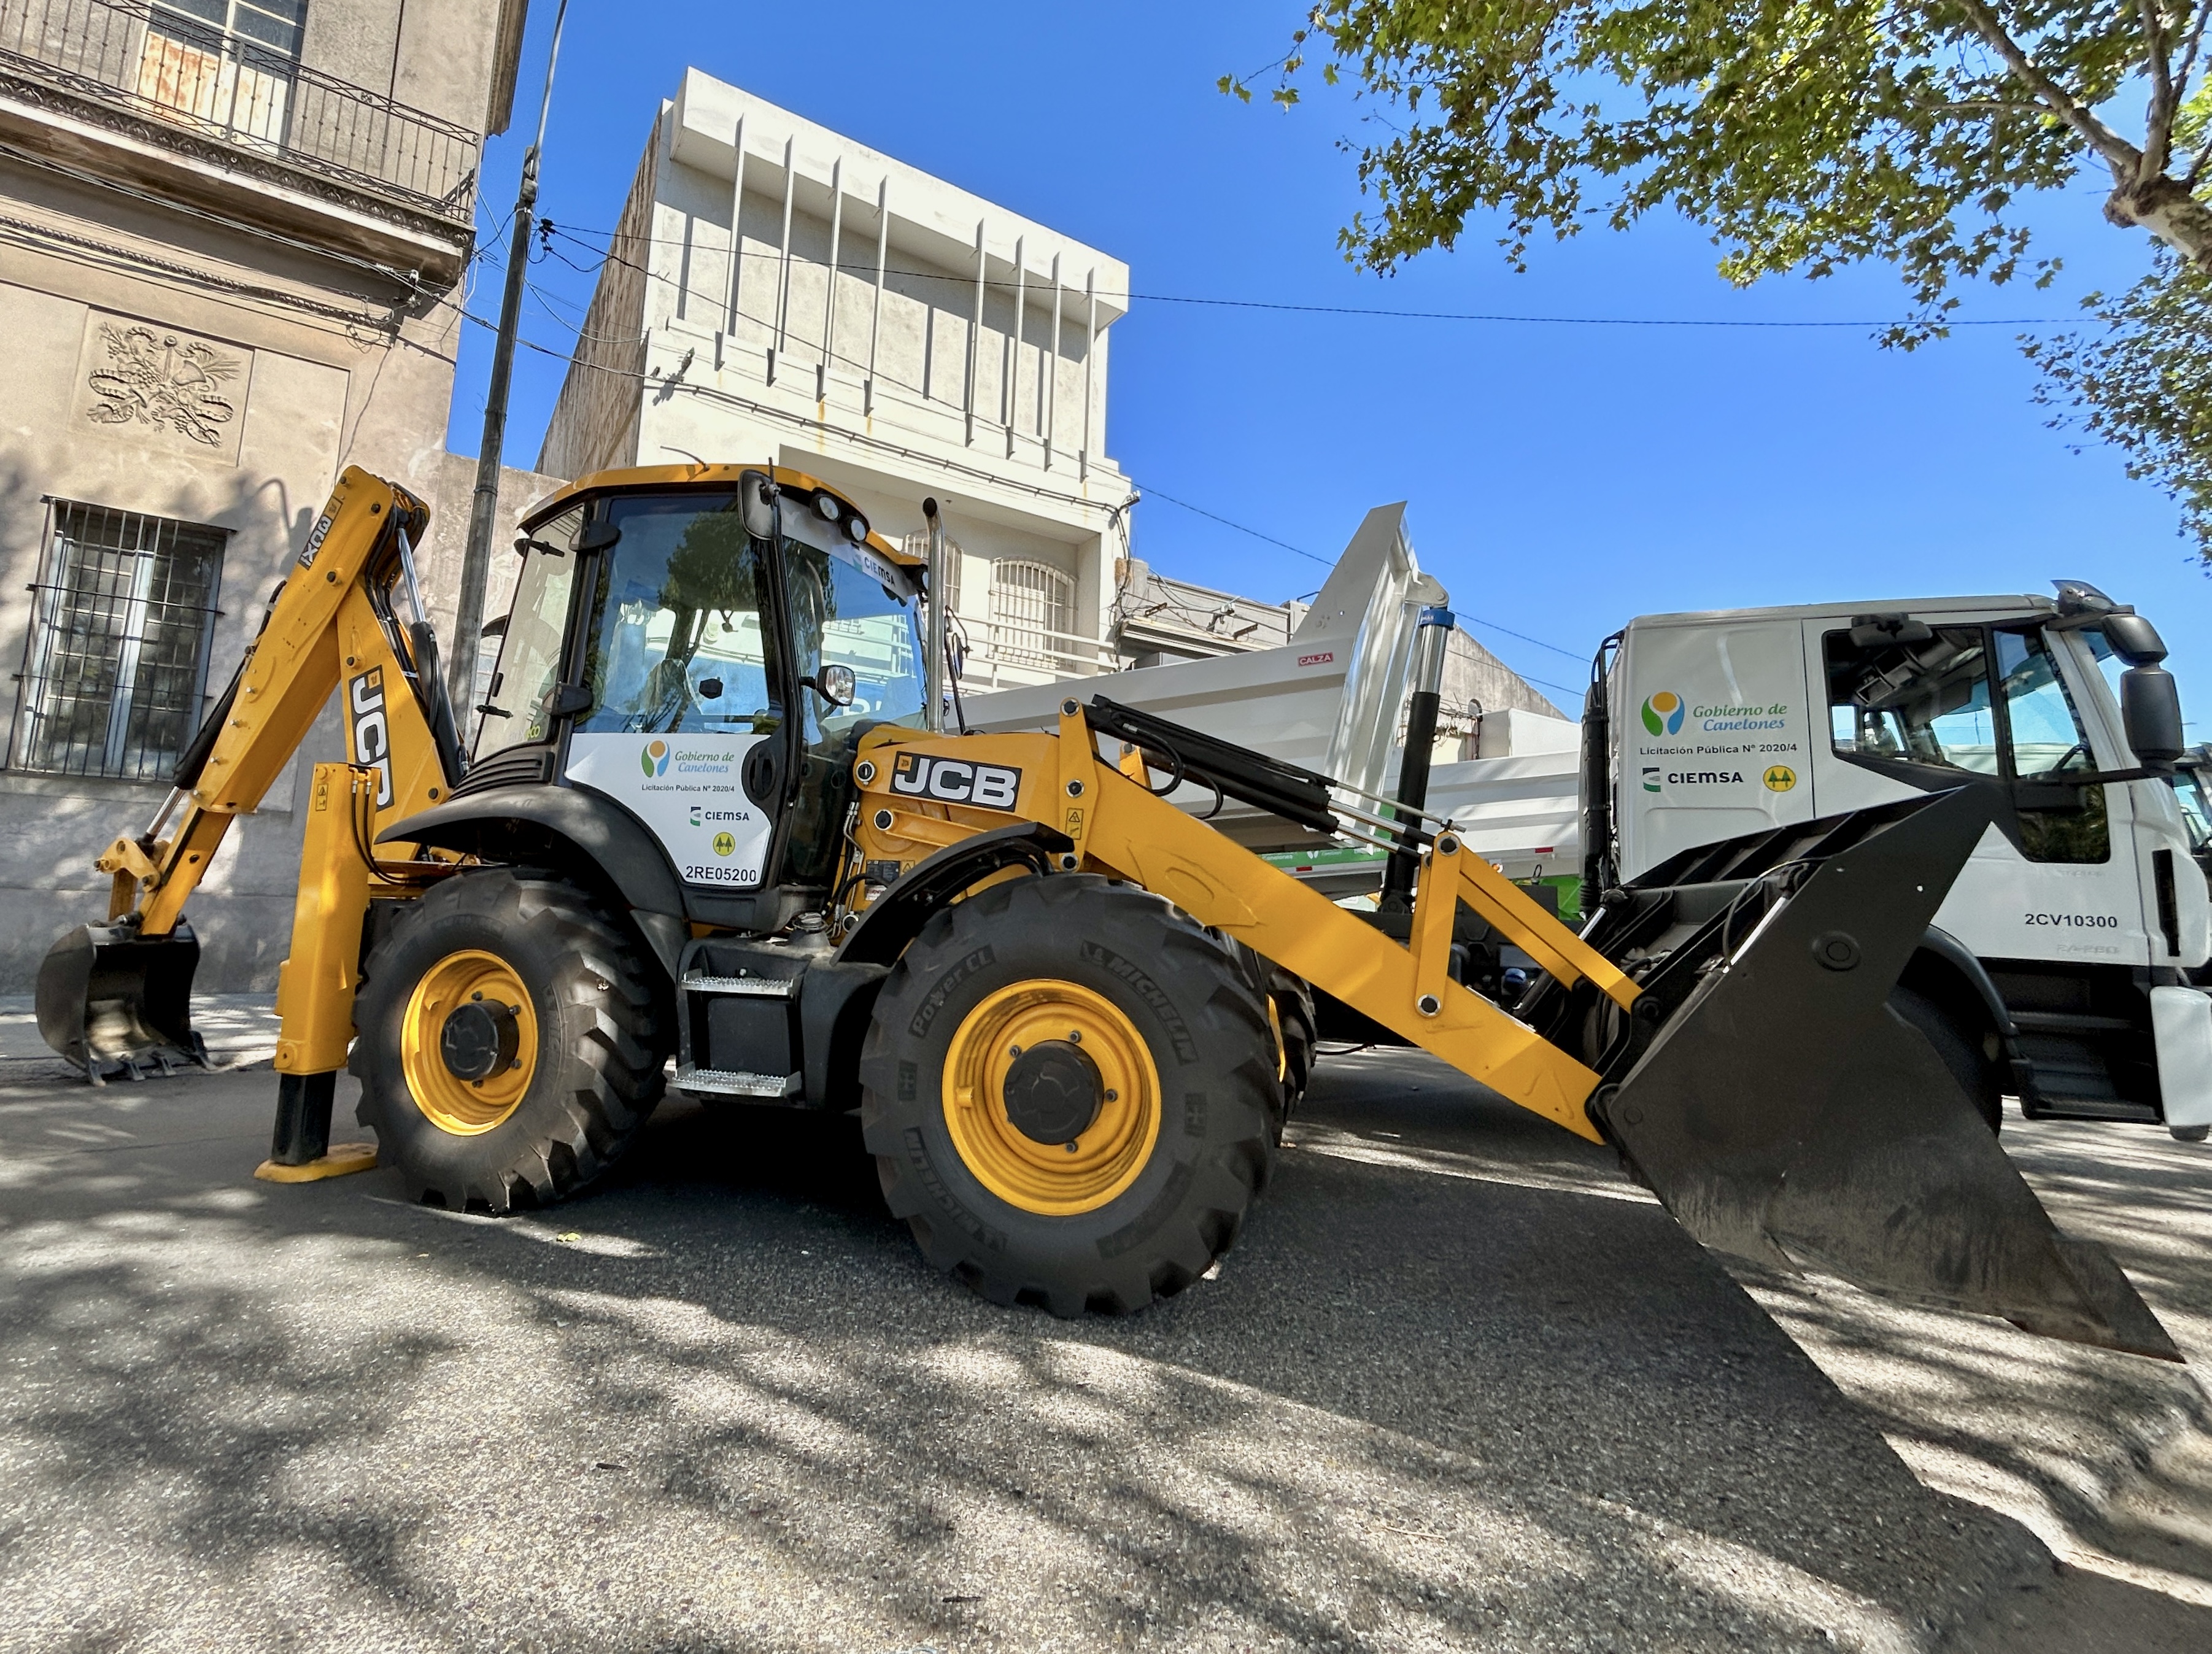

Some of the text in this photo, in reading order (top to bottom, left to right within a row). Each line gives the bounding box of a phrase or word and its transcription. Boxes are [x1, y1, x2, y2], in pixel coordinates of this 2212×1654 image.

[302, 516, 331, 563] 3CX
[864, 557, 896, 587] CIEMSA
[1692, 703, 1787, 717] Gobierno de
[1703, 718, 1785, 732] Canelones
[675, 751, 735, 762] Gobierno de
[1640, 746, 1693, 756] Licitación
[1696, 744, 1739, 754] Pública
[1758, 743, 1797, 753] 2020/4
[678, 762, 729, 773] Canelones
[894, 757, 1017, 807] JCB
[1668, 771, 1744, 784] CIEMSA
[641, 783, 674, 792] Licitación
[705, 811, 749, 821] CIEMSA
[686, 865, 757, 883] 2RE05200
[2025, 913, 2118, 928] 2CV10300
[912, 951, 992, 1036] Power CL
[1107, 956, 1198, 1064] MICHELIN
